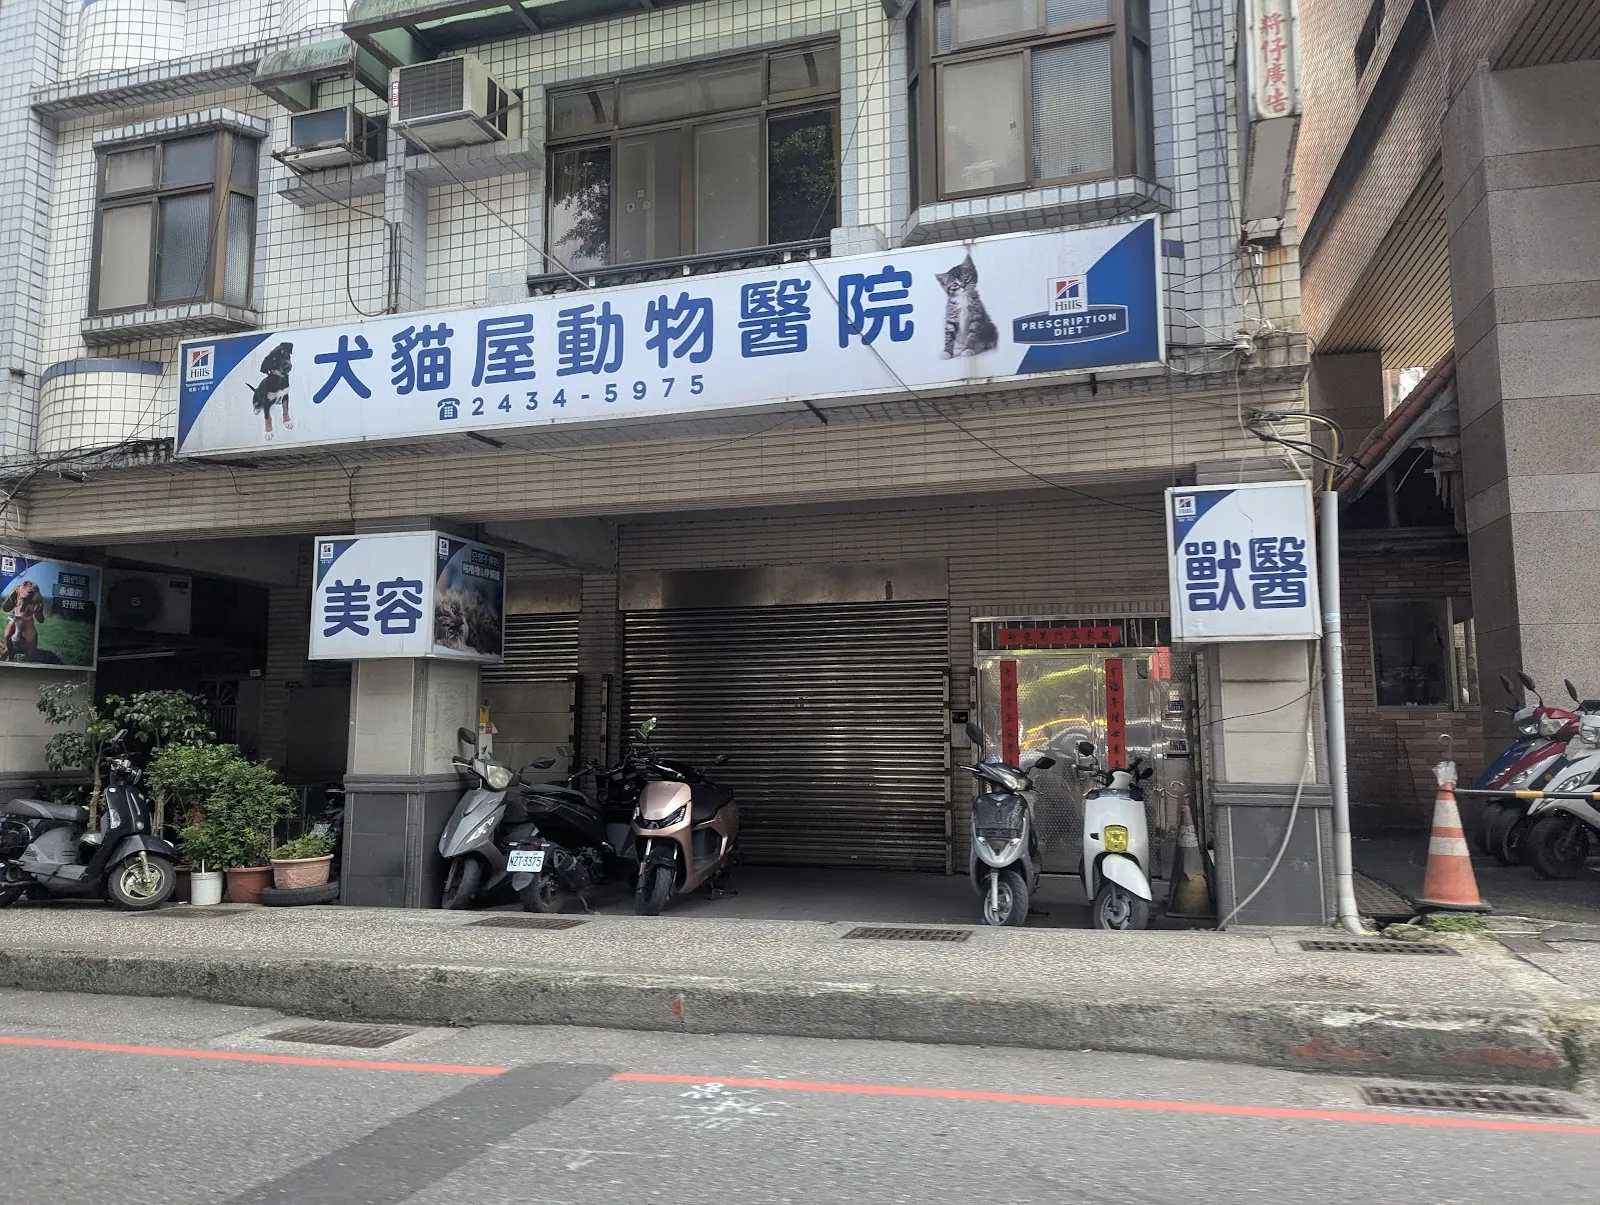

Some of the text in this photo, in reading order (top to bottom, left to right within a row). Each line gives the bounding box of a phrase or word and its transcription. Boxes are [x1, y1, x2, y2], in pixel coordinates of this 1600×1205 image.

[1021, 312, 1118, 331] PRESCRIPTION
[1054, 300, 1083, 312] Hill's
[312, 265, 915, 405] 犬貓屋動物醫院
[190, 367, 210, 378] Hill's
[471, 374, 704, 417] 2434-5975
[1184, 536, 1308, 611] 獸醫
[323, 576, 424, 638] 美容
[509, 856, 542, 867] NZT-3375
